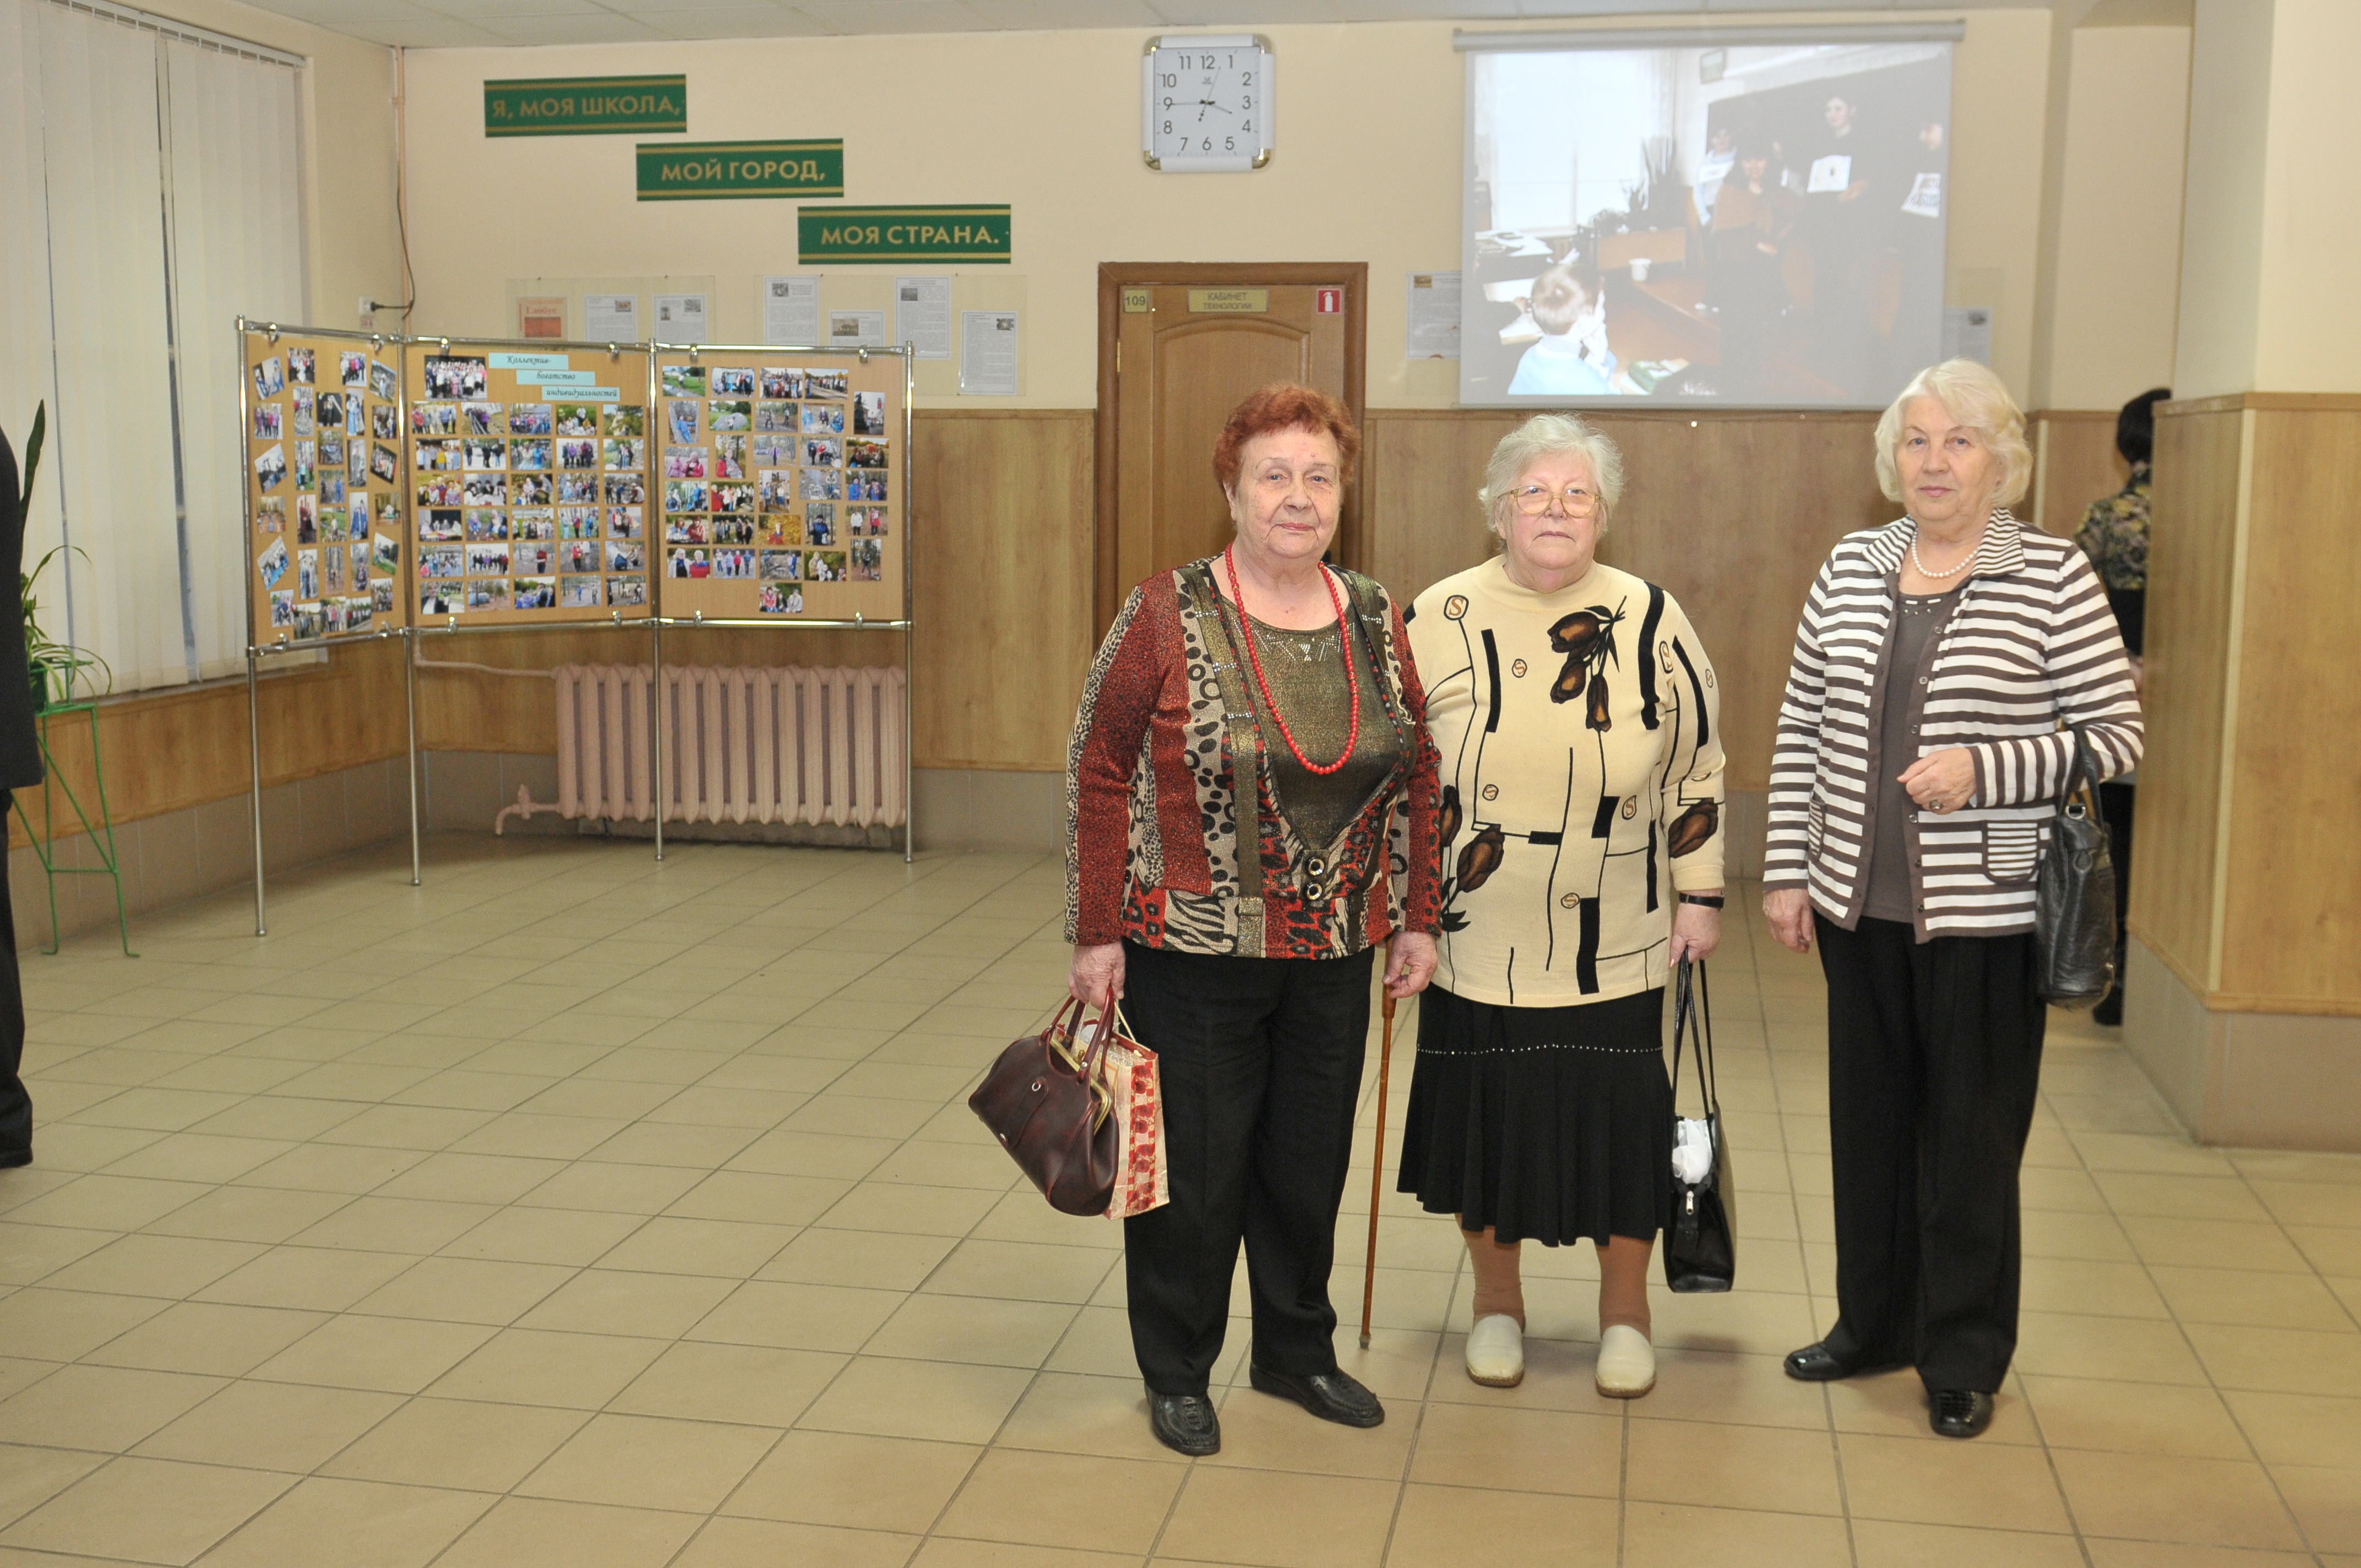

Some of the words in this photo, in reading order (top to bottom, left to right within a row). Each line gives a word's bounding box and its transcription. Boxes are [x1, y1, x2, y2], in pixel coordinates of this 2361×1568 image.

[1200, 55, 1215, 69] 12
[1161, 73, 1177, 88] 10
[1242, 72, 1252, 85] 2
[492, 99, 514, 120] Я,
[519, 97, 575, 118] МОЯ
[581, 95, 681, 116] ШКОЛА,
[1163, 96, 1173, 111] 9
[1242, 95, 1252, 110] 3
[1163, 120, 1172, 134] 8
[1242, 119, 1250, 133] 4
[1180, 137, 1188, 151] 7
[1202, 137, 1211, 151] 6
[1225, 136, 1235, 150] 5
[661, 157, 722, 181] МОЙ
[730, 160, 825, 182] ГОРОД,
[820, 225, 880, 245] МОЯ
[886, 225, 999, 244] СТРАНА.
[1125, 295, 1146, 306] 109
[1206, 292, 1247, 301] КАБИНЕТ
[546, 388, 617, 399] индивидуальностей
